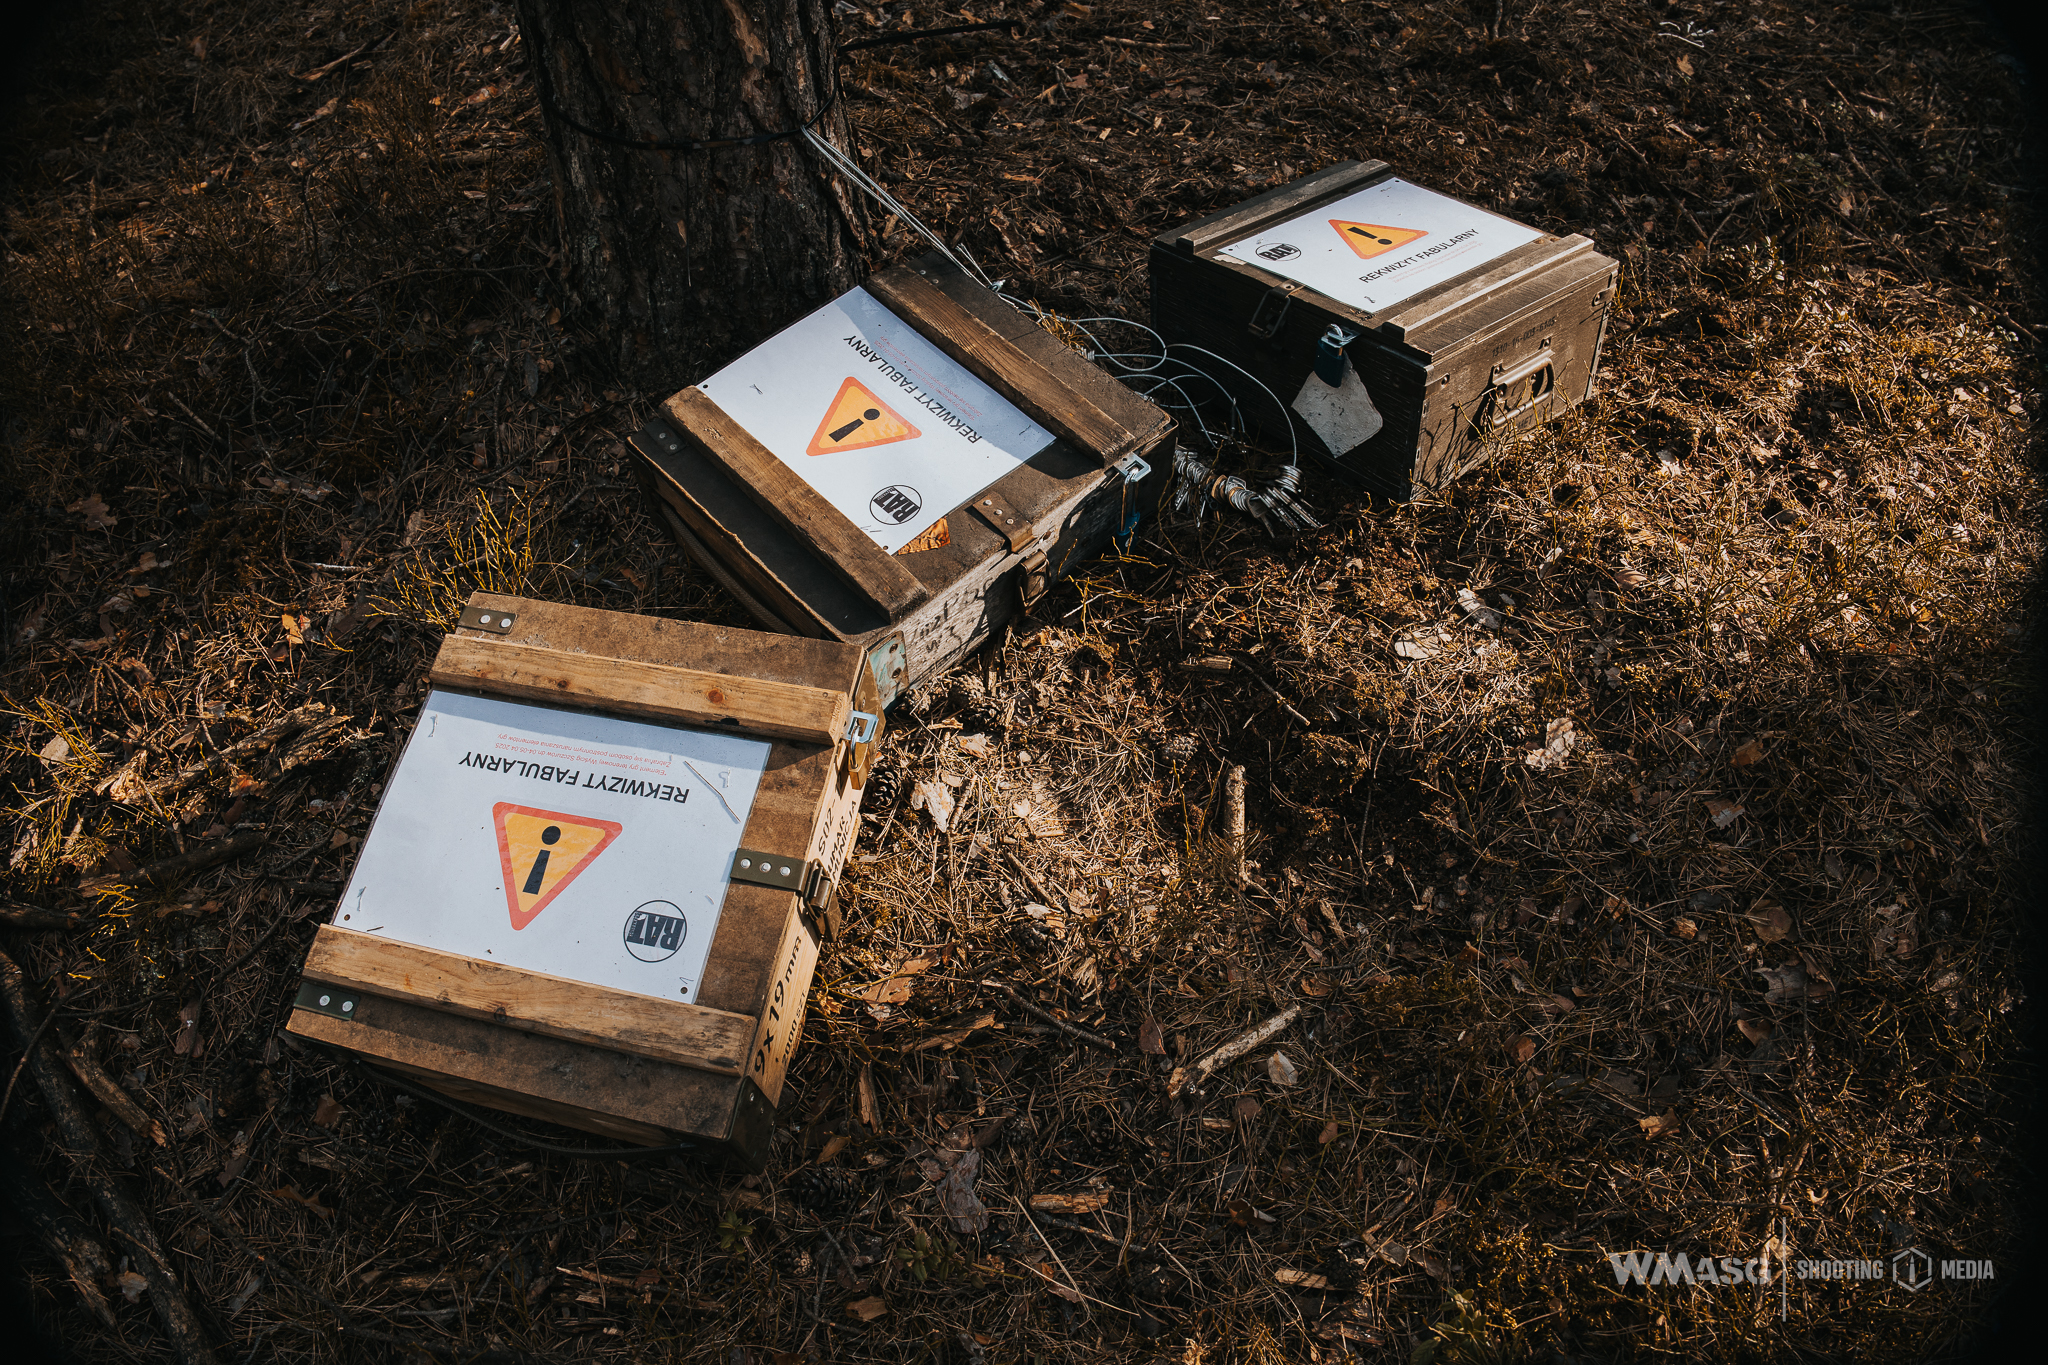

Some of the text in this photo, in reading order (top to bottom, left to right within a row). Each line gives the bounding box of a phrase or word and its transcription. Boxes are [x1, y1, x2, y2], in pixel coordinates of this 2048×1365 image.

[1260, 243, 1298, 261] RAT
[1359, 257, 1417, 283] REKWIZYT
[1415, 228, 1479, 259] FABULARNY
[843, 335, 982, 444] REKWIZYT FABULARNY
[873, 487, 920, 523] RAT
[458, 751, 690, 804] REKWIZYT FABULARNY
[608, 752, 632, 761] osobom
[827, 816, 845, 873] UMAR
[832, 800, 856, 880] MUNICJA
[626, 911, 685, 951] RAT
